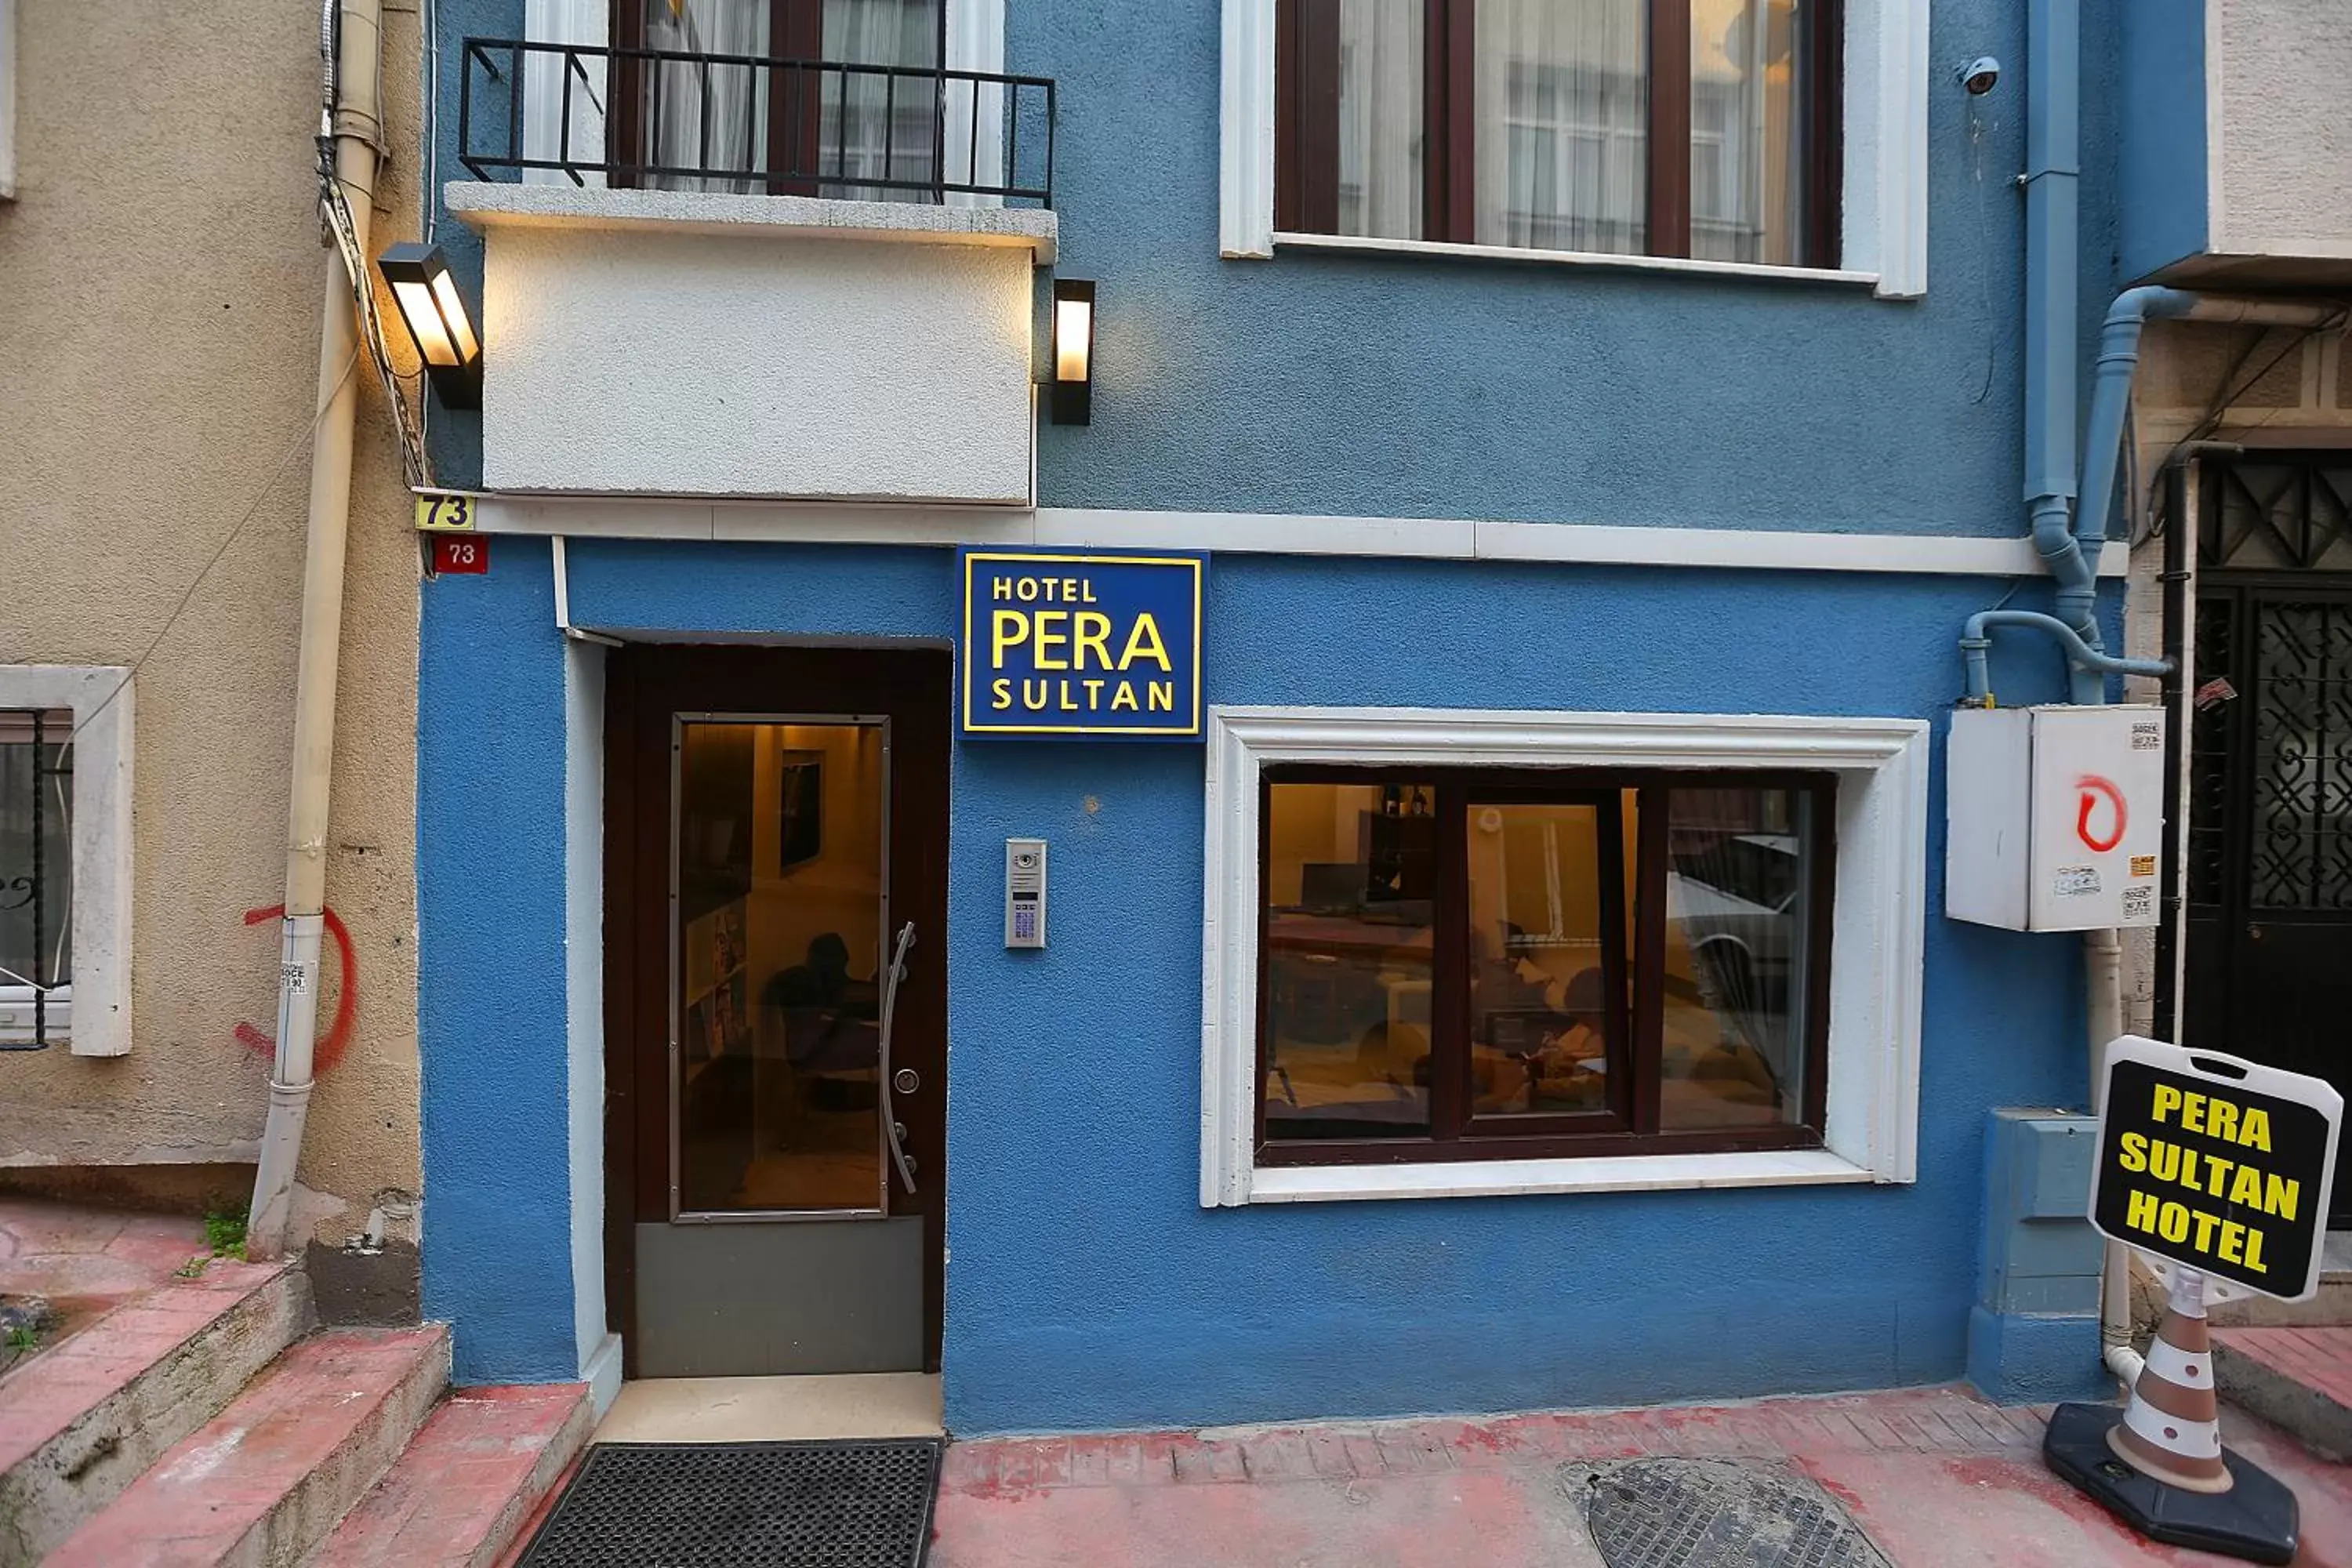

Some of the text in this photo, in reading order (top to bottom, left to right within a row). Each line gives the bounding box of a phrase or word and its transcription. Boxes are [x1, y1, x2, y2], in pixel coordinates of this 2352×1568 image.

[423, 495, 468, 526] 73
[448, 543, 475, 564] 73
[993, 576, 1098, 602] HOTEL
[992, 609, 1173, 673] PERA
[992, 678, 1174, 712] SULTAN
[2152, 1083, 2272, 1153] PERA
[2118, 1131, 2301, 1221] SULTAN
[2125, 1189, 2268, 1274] HOTEL
